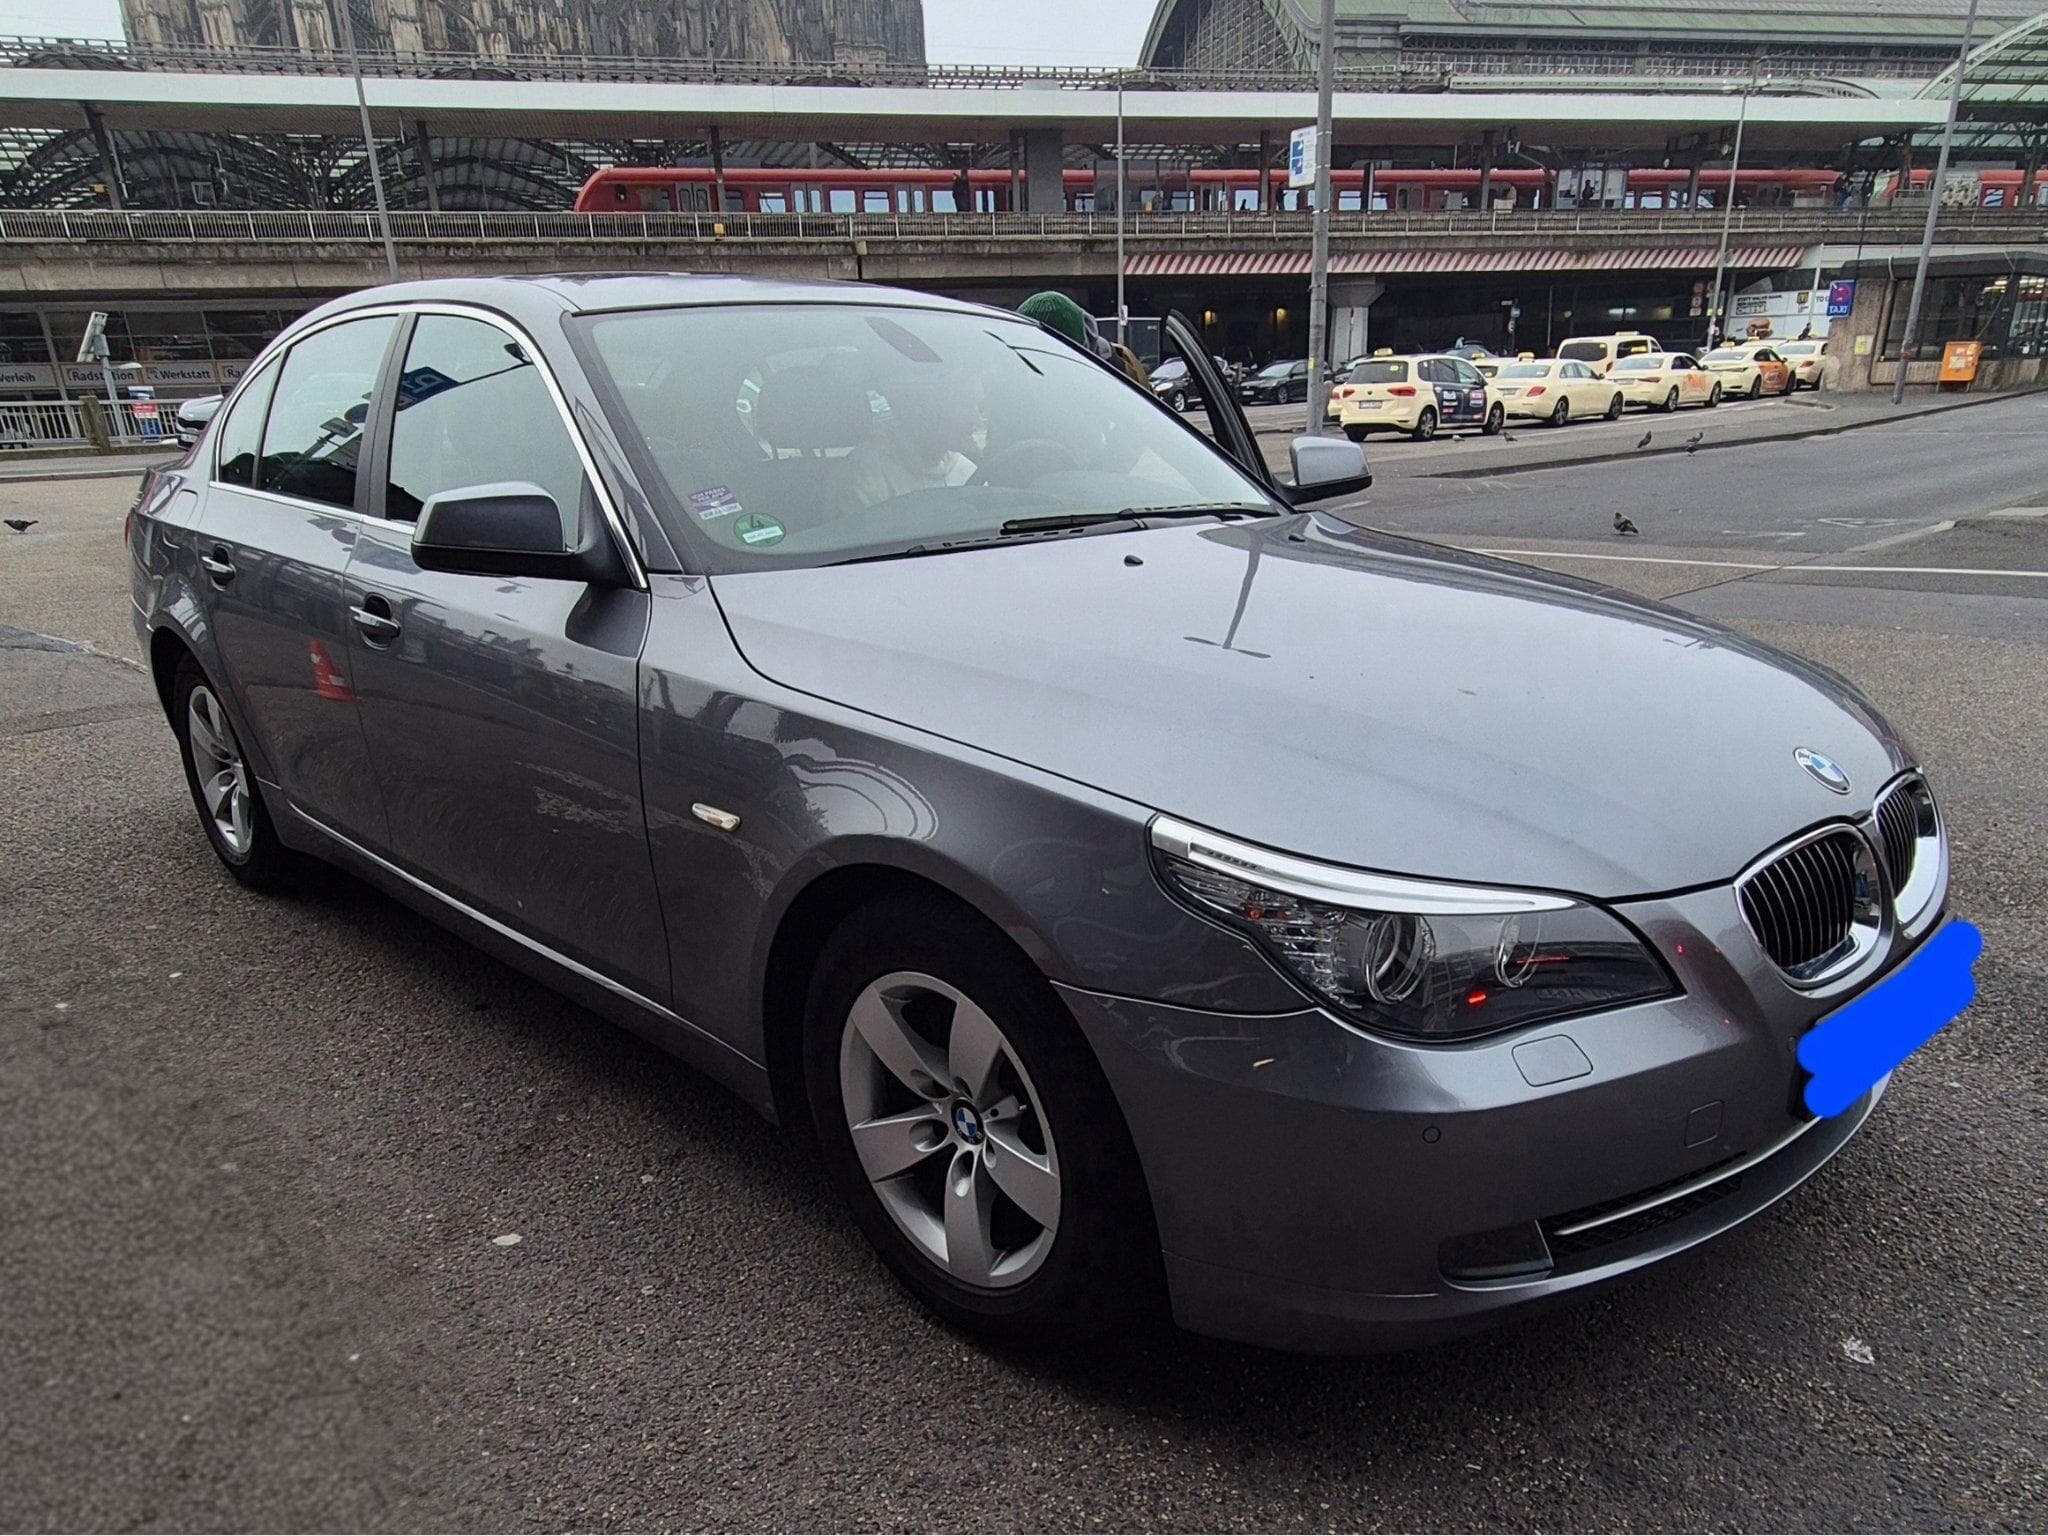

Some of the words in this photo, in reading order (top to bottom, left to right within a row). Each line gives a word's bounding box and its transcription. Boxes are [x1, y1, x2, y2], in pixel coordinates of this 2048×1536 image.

[1829, 305, 1848, 314] TAXI
[72, 370, 134, 381] Radsttion
[160, 369, 211, 380] Werkstatt
